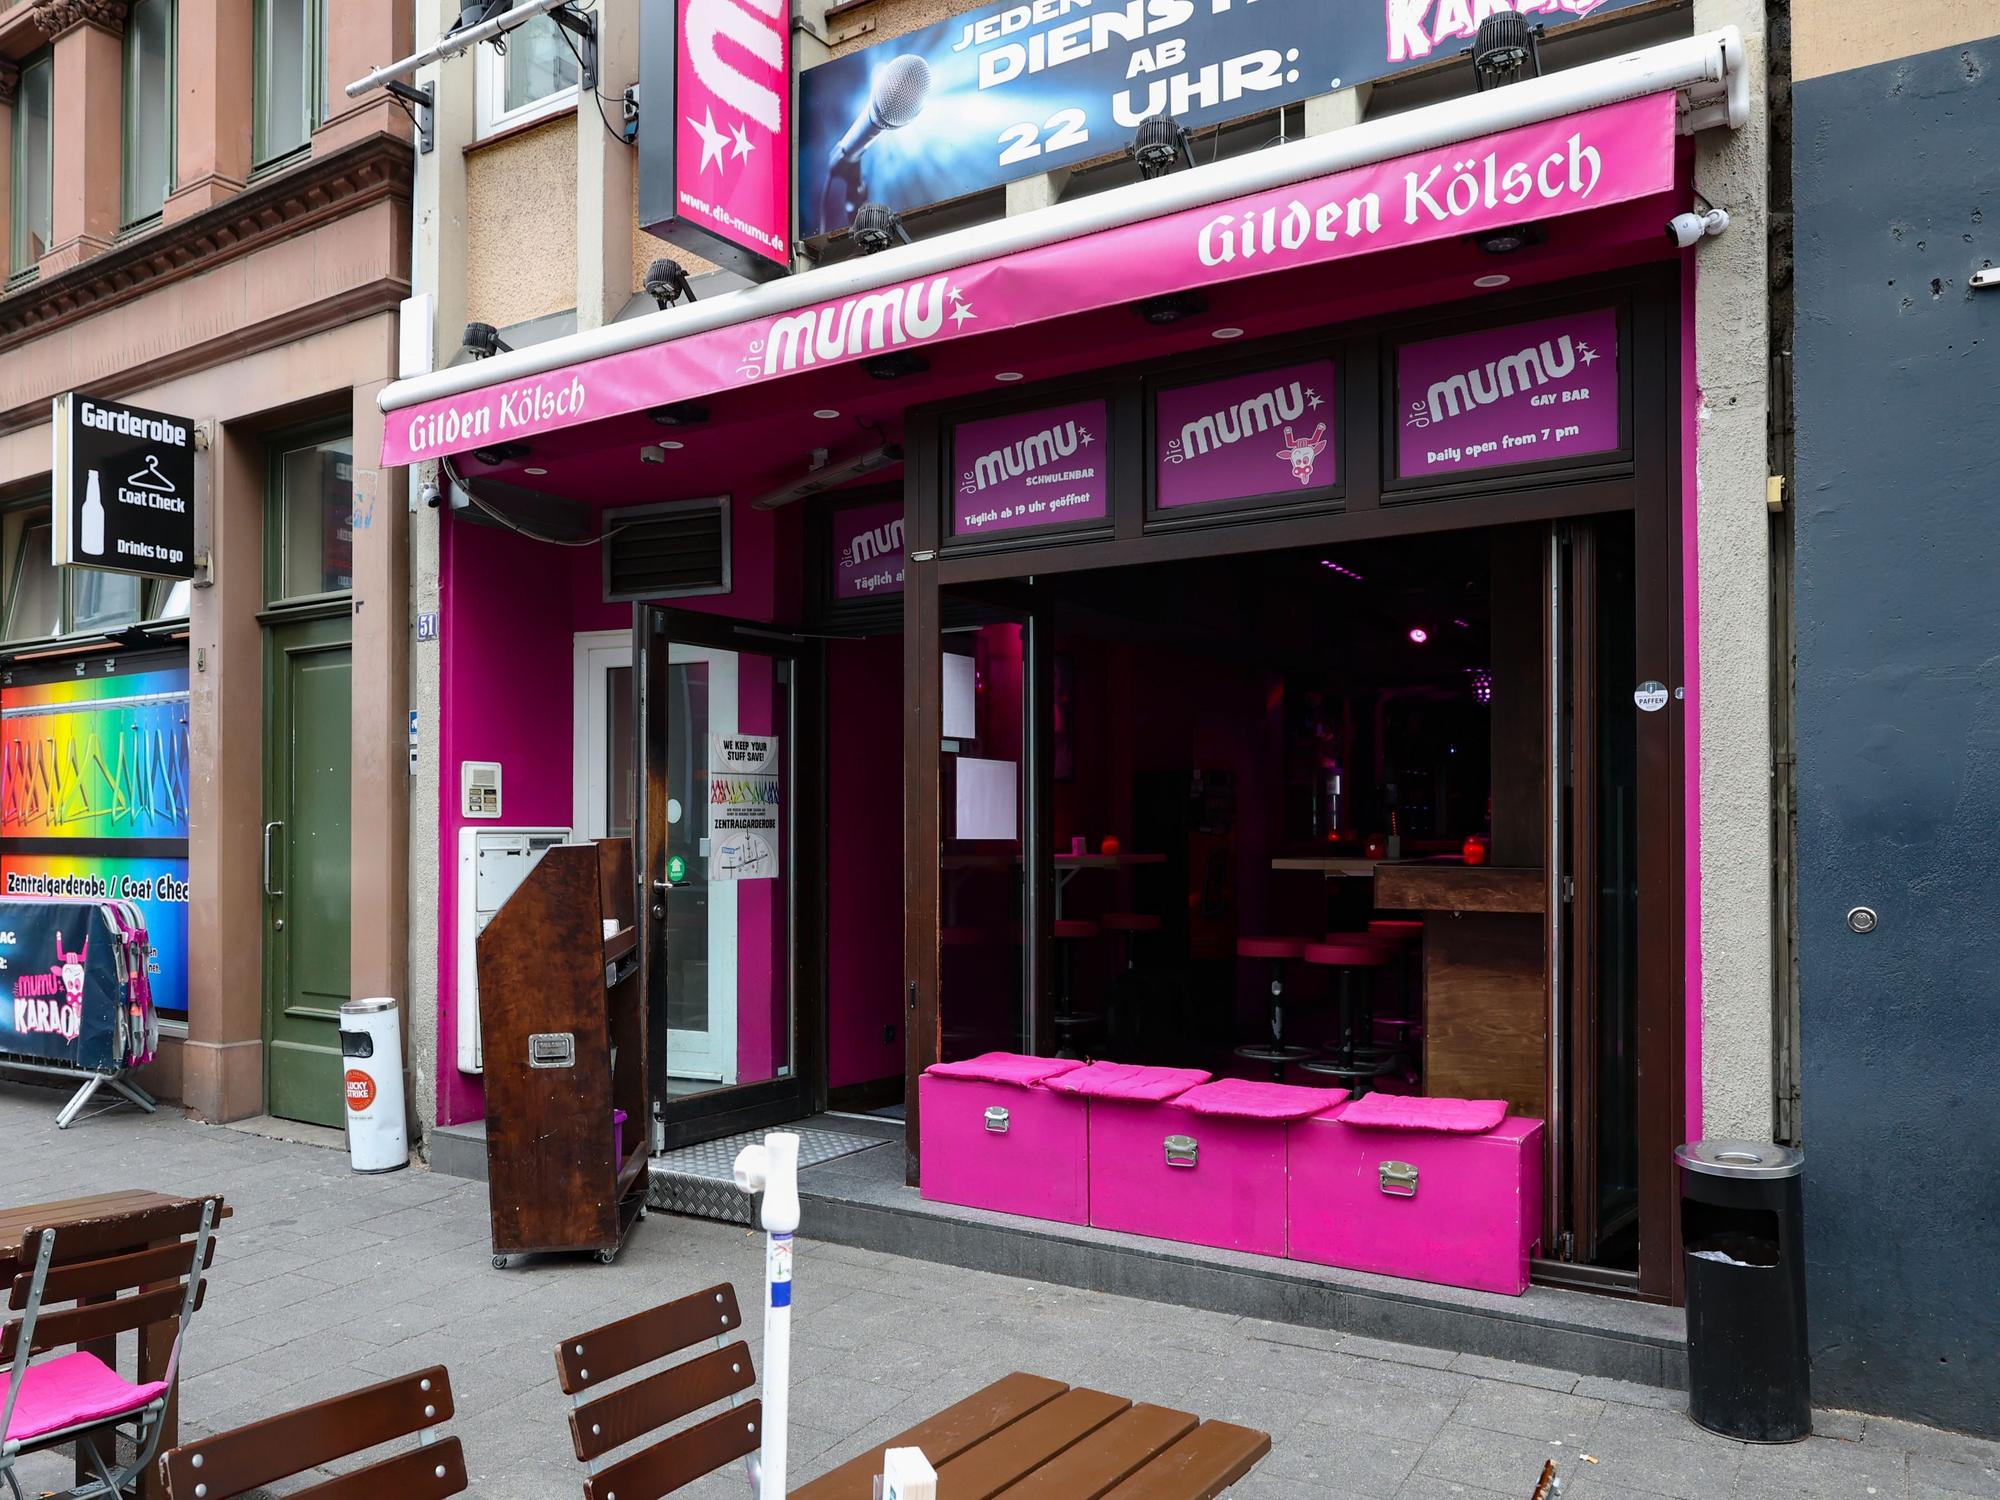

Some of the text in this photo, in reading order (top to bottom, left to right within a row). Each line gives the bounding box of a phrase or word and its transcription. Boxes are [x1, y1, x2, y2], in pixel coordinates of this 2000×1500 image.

[978, 0, 1254, 90] DIENS
[1125, 38, 1187, 80] AB
[998, 48, 1300, 166] 22 UHR:
[1198, 132, 1602, 267] Gilden Kölsch
[680, 190, 784, 252] www.die-mumu.de
[736, 338, 764, 379] die
[1530, 388, 1590, 407] GAY BAR
[81, 402, 187, 447] Garderobe
[408, 375, 586, 451] Gilden Kölsch
[1406, 400, 1430, 428] die
[1163, 437, 1184, 464] die
[1427, 425, 1579, 464] Daily open from 7 pm
[960, 470, 976, 494] die
[1026, 468, 1095, 486] SCHWULENBAR
[118, 487, 186, 513] Coat Check
[964, 492, 1091, 527] Täglich ab 19 Uhr geöffnet
[117, 539, 184, 564] Drinks to go
[854, 571, 892, 591] Täglich
[420, 614, 434, 636] 51
[723, 740, 767, 751] WE KEEP YOUR
[727, 751, 746, 760] STUFF
[714, 818, 776, 829] ZENTRALGARDEROBE
[8, 874, 105, 896] Zentralgarderobe
[121, 877, 152, 899] Coat
[157, 875, 188, 900] Chec
